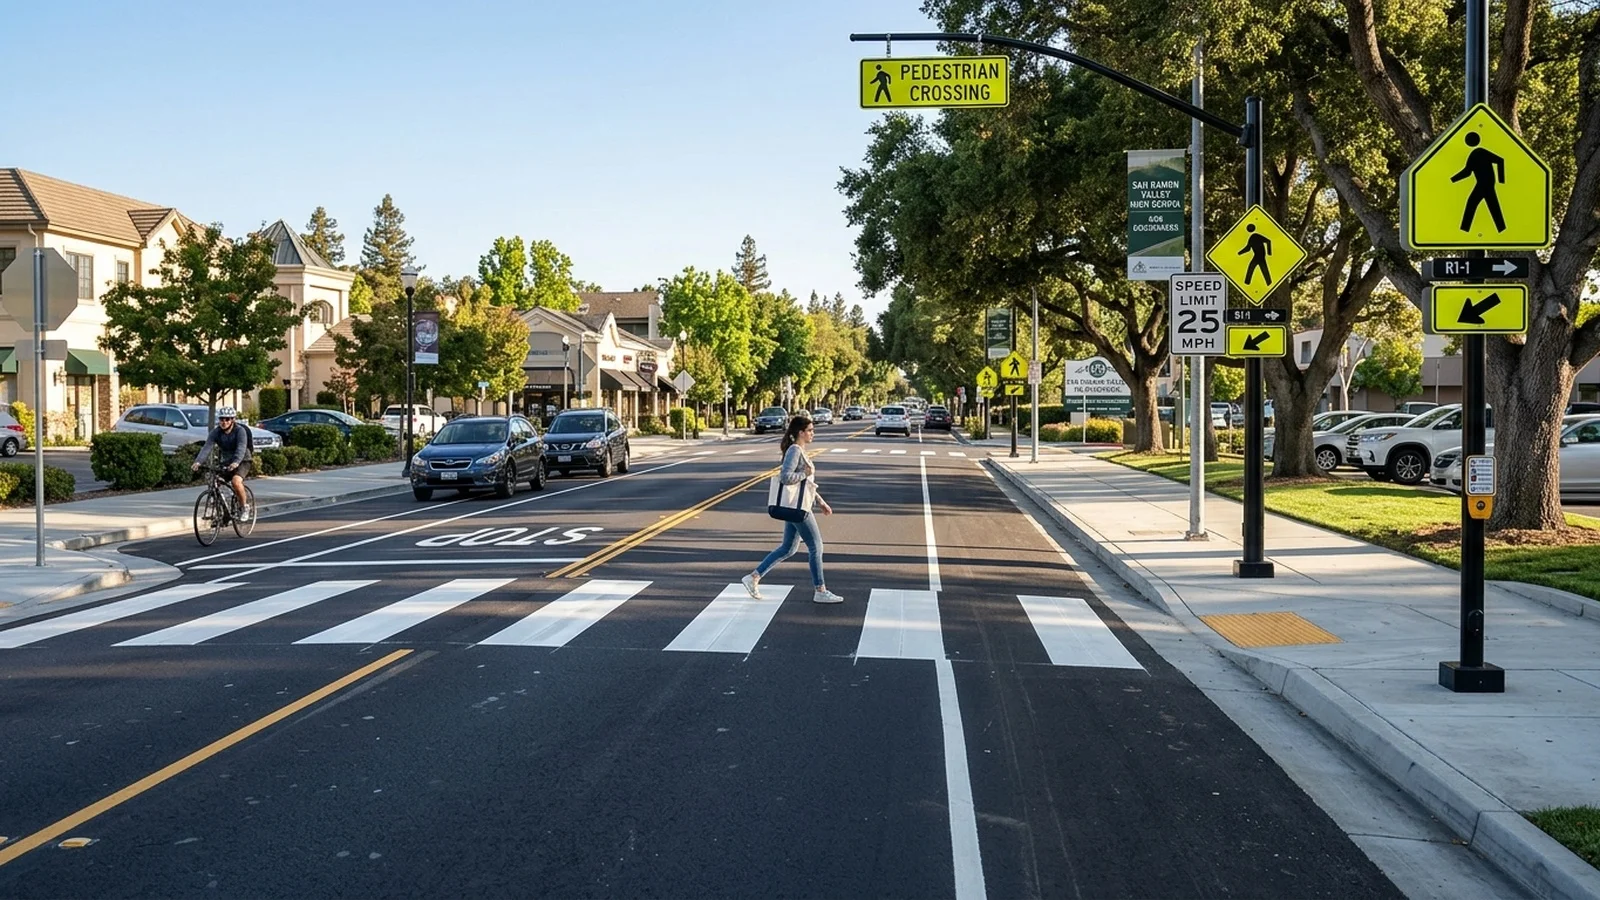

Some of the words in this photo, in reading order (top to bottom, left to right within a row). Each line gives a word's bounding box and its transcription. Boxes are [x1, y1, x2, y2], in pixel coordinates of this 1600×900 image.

[901, 63, 999, 80] PEDESTRIAN
[910, 84, 990, 101] CROSSING
[1445, 261, 1470, 274] R1-1
[1175, 280, 1222, 291] SPEED
[1180, 295, 1217, 305] LIMIT
[1177, 309, 1220, 334] 25
[1182, 338, 1214, 348] MPH
[415, 527, 604, 546] STOP
